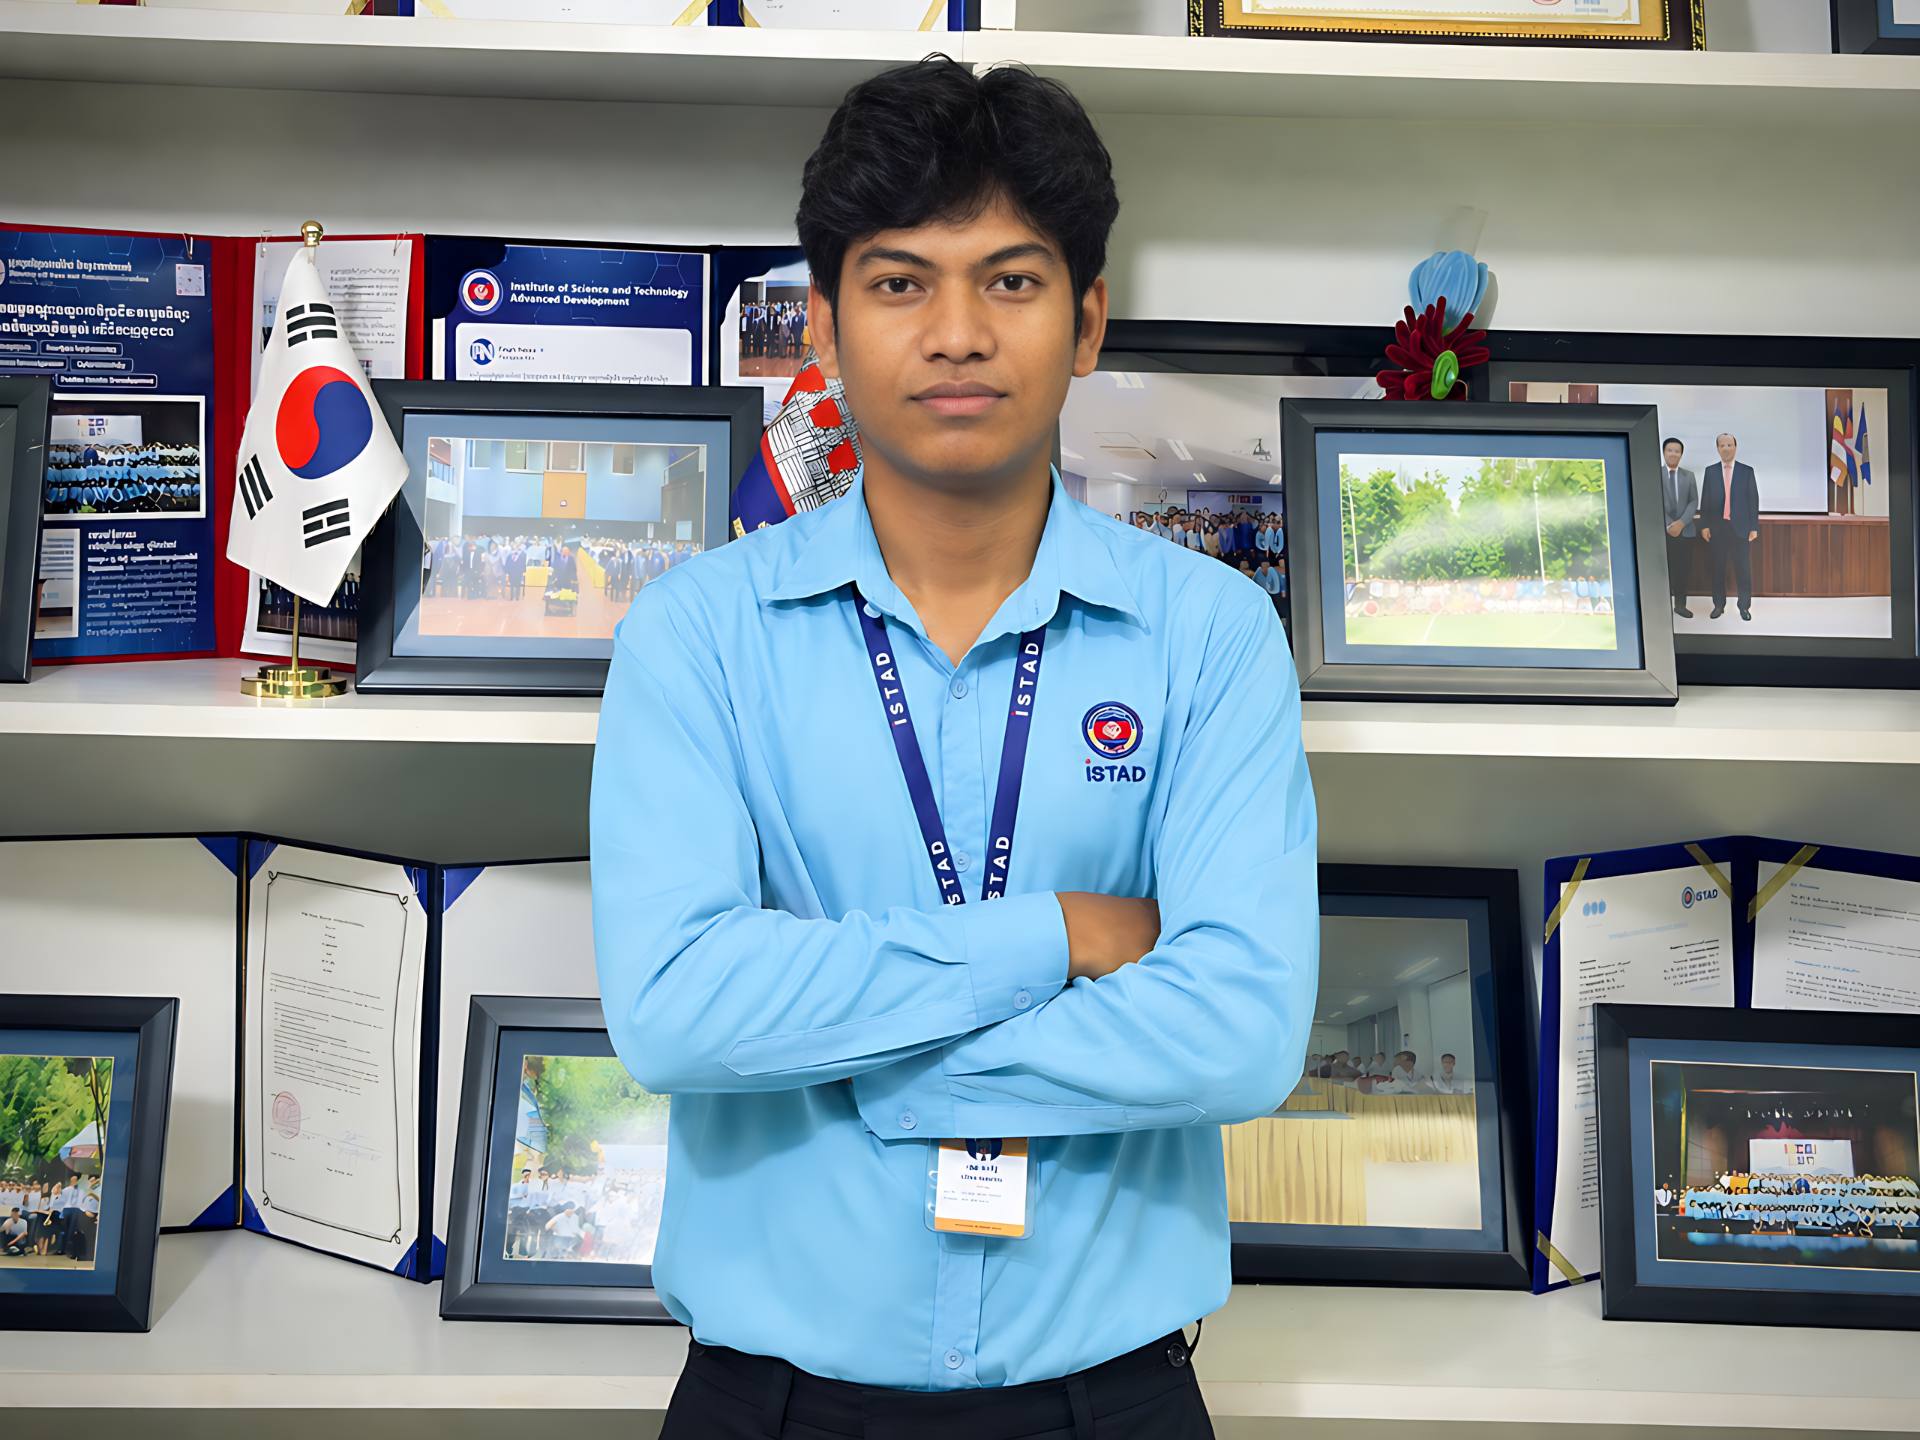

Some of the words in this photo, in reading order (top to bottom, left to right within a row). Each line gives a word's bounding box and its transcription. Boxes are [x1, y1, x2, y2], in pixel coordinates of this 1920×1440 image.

[557, 283, 569, 292] of
[612, 285, 632, 295] and
[876, 652, 908, 727] iSTAD
[1010, 643, 1039, 717] iSTAD
[1085, 758, 1146, 782] iSTAD
[931, 840, 961, 905] STAD
[987, 836, 1010, 899] STAD
